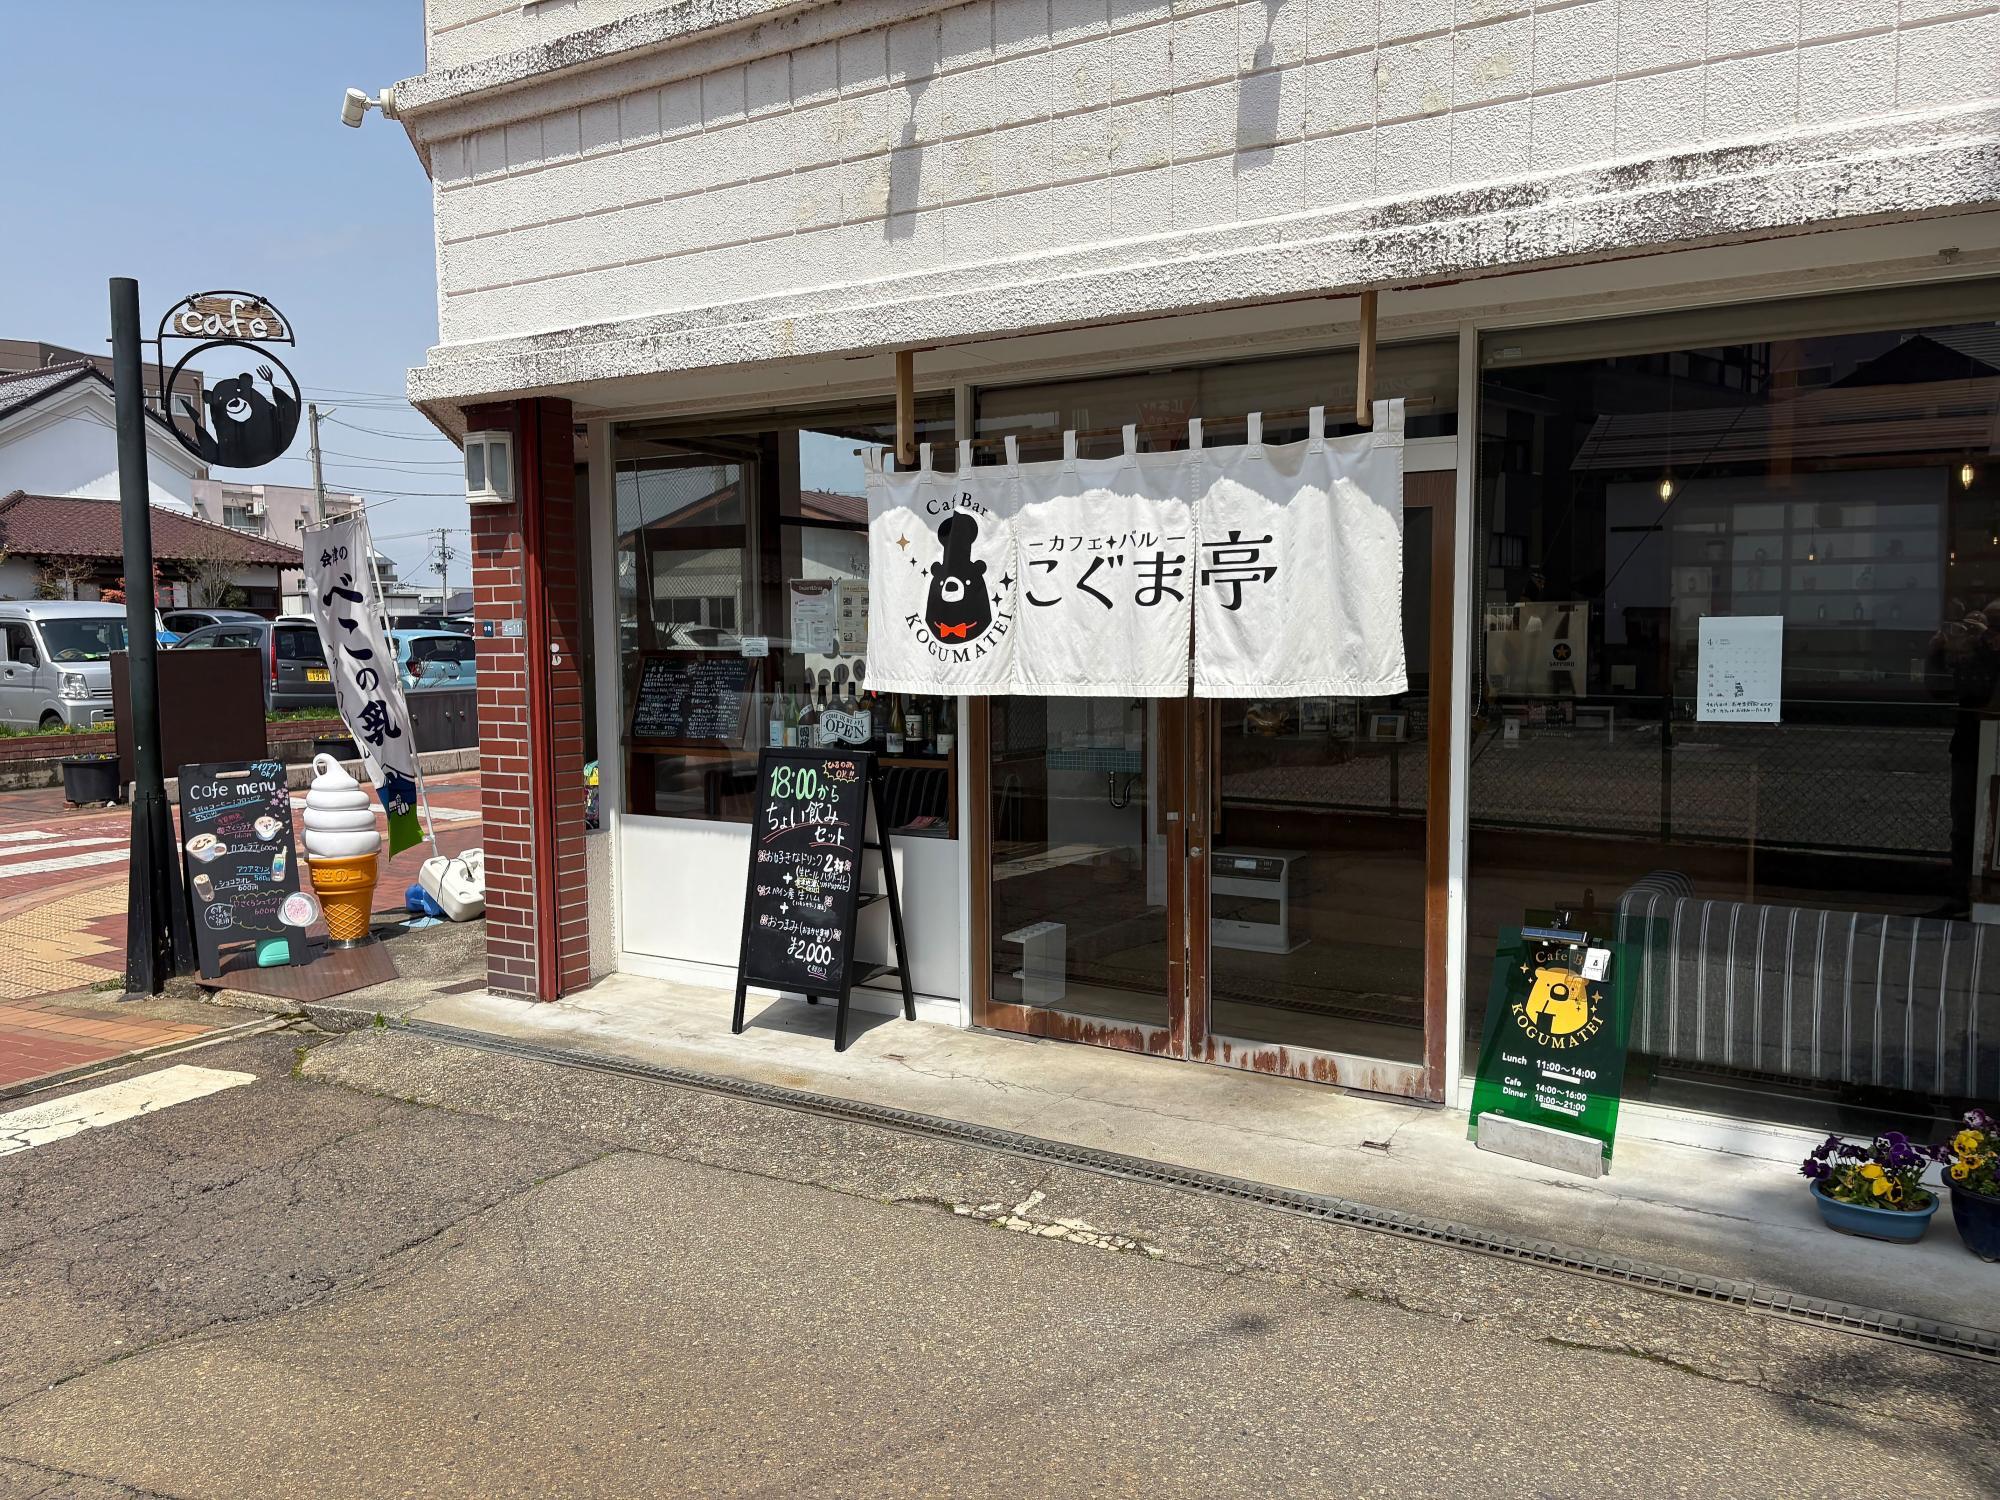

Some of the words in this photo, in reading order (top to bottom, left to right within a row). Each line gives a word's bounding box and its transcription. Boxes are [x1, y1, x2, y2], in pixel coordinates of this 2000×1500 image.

[181, 300, 268, 338] cafe
[960, 491, 989, 517] Bar
[320, 545, 349, 568] 会津の
[1025, 530, 1278, 611] こぐま亭
[905, 611, 1013, 663] KOGUMATEI
[322, 572, 402, 747] べこの乳
[825, 718, 864, 739] OPEN
[250, 762, 283, 772] テイクアウト
[190, 781, 229, 800] Cafe
[236, 780, 277, 796] menu
[770, 765, 817, 800] 18:00
[817, 784, 840, 803] から
[766, 801, 839, 830] ちょい飲み
[814, 826, 845, 846] セット
[1535, 949, 1568, 963] Cafe
[1512, 1002, 1604, 1049] KOGUMATEI
[1502, 1052, 1527, 1065] Lunch
[1502, 1086, 1528, 1099] Dinner
[1504, 1076, 1522, 1087] Cafe
